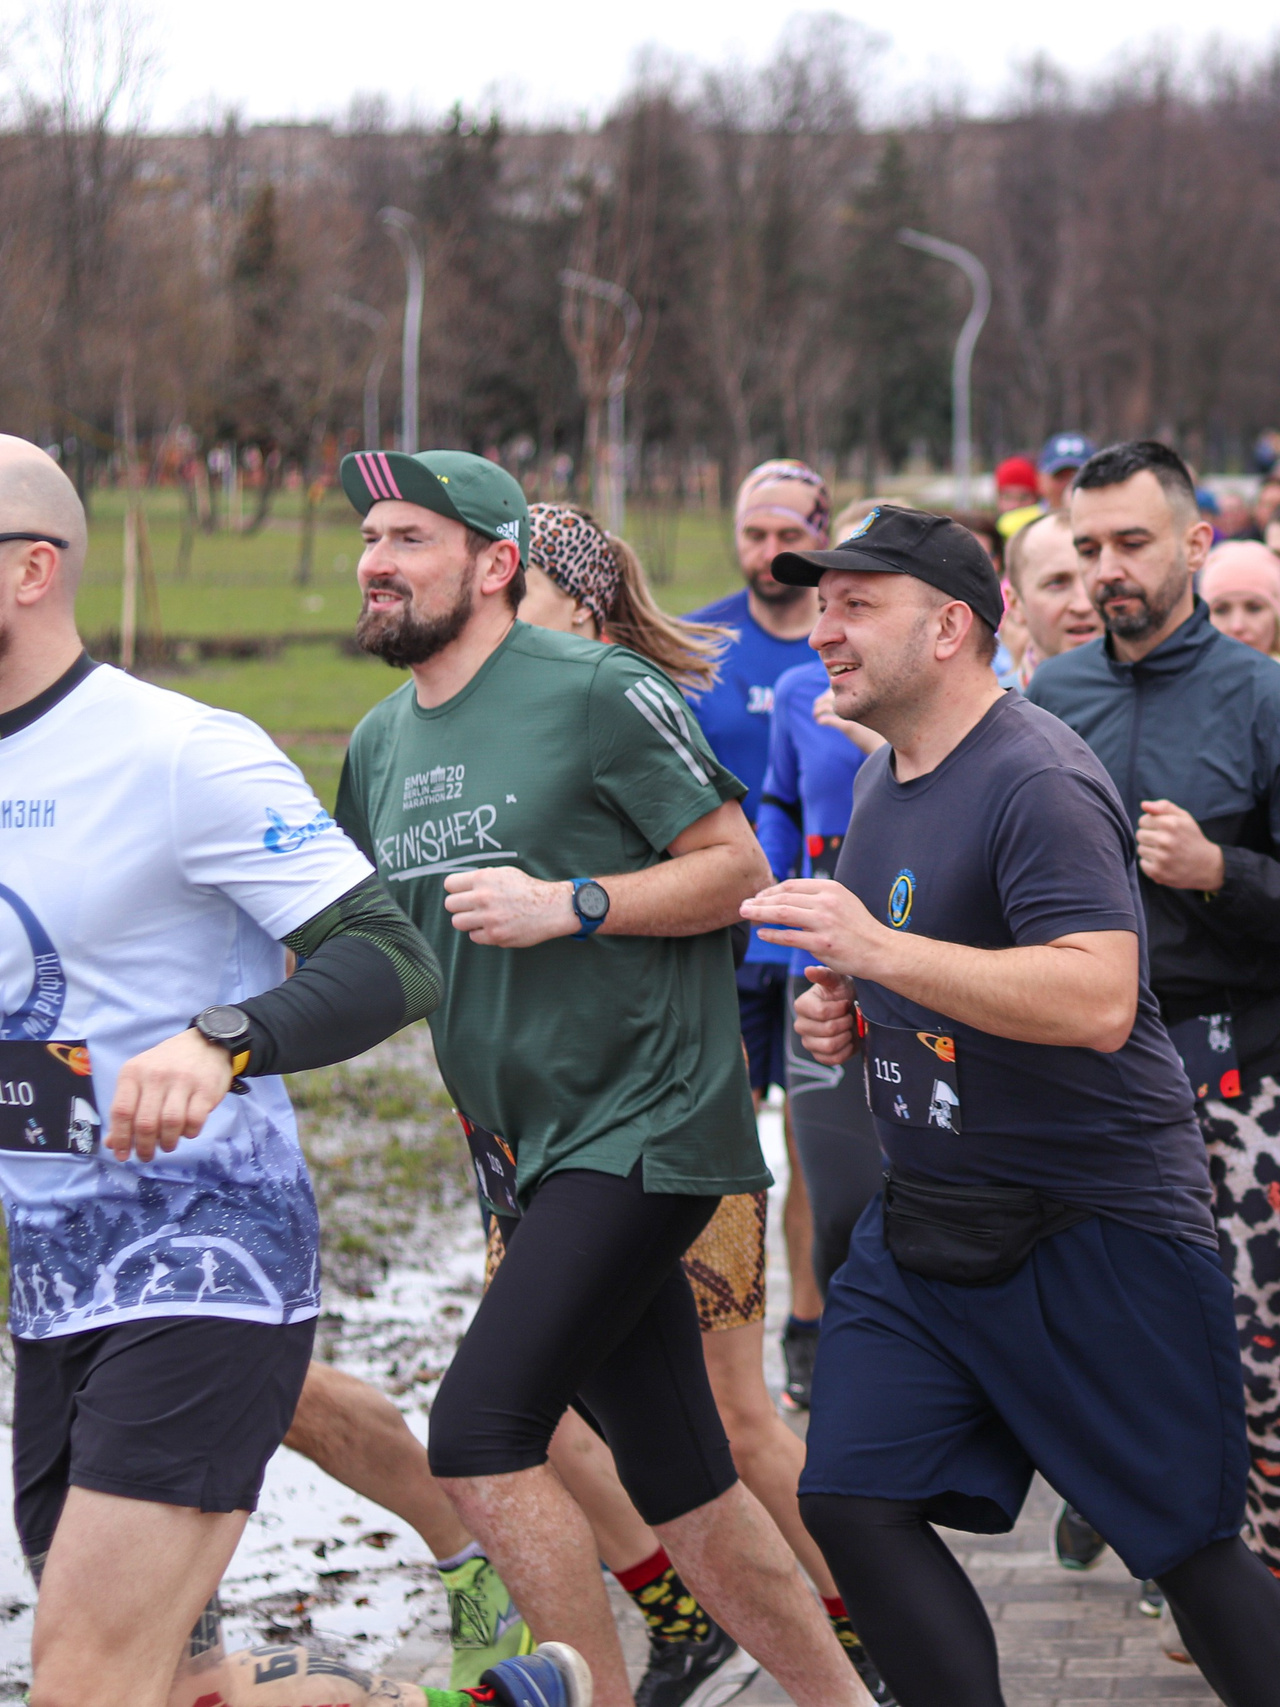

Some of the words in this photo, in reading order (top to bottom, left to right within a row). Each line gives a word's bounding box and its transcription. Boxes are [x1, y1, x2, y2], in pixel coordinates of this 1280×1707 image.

[405, 772, 429, 790] BMW
[446, 764, 465, 782] 20
[446, 782, 462, 800] 22
[402, 794, 445, 811] MARATHON
[0, 799, 55, 828] ИЗНИ
[22, 952, 64, 1040] МАРАФОН
[875, 1057, 902, 1083] 115
